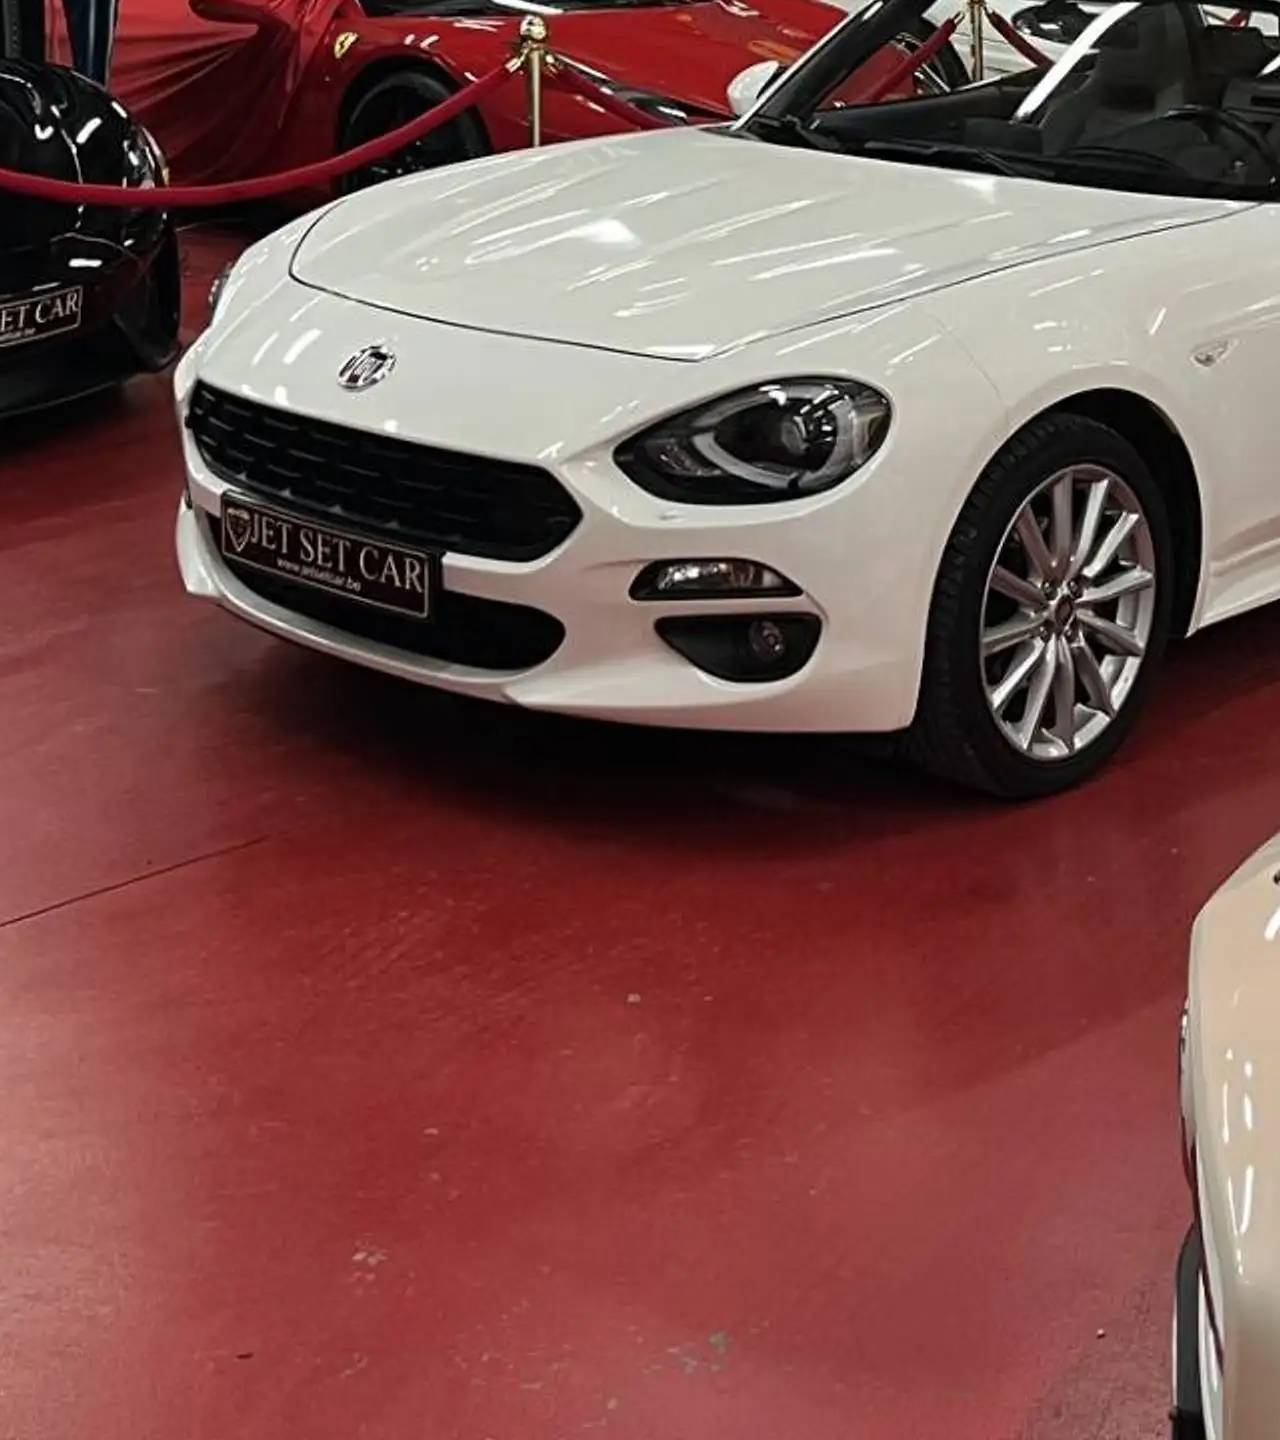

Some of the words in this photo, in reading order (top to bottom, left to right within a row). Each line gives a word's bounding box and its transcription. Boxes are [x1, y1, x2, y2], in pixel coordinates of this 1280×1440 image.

[35, 292, 77, 324] CAR
[250, 513, 292, 554] JET
[300, 528, 351, 572] SET
[359, 546, 424, 593] CAR
